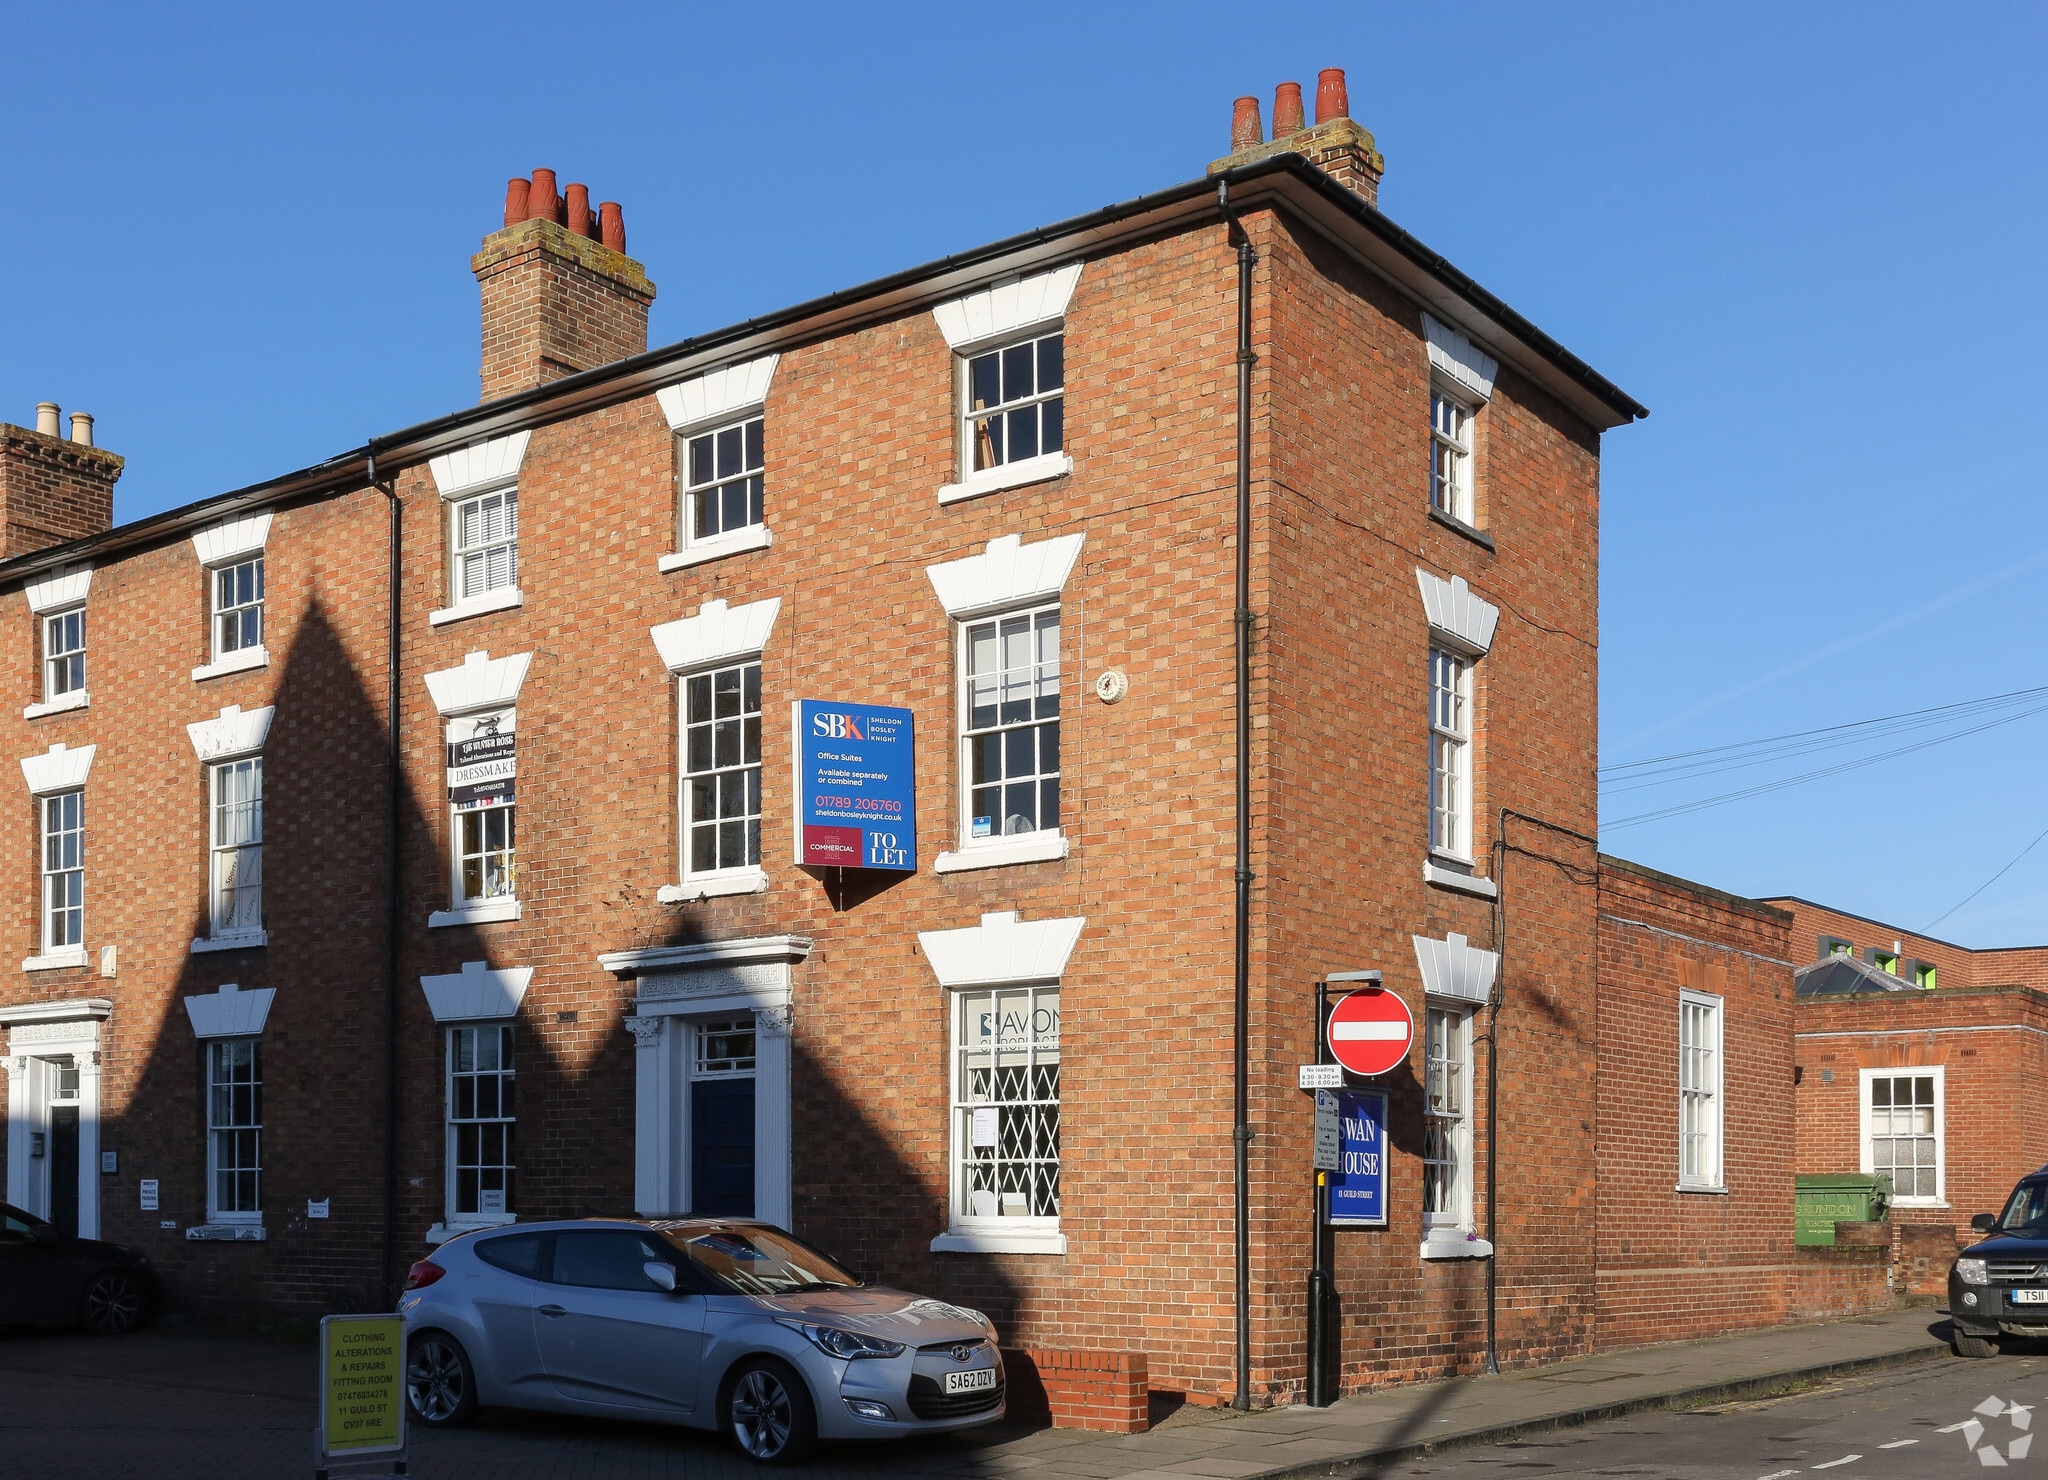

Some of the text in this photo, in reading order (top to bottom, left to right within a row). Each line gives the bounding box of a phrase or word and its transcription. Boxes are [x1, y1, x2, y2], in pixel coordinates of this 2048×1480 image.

[813, 712, 864, 740] SBK
[871, 717, 902, 725] SHELDON
[871, 726, 896, 734] BOSLEY
[817, 752, 863, 762] Office Suites
[818, 768, 888, 781] Available separately
[827, 777, 863, 786] combined
[815, 795, 902, 812] 01789 206760
[815, 809, 902, 821] sheldonbosleyknight.co.uk
[870, 831, 897, 849] TO
[810, 843, 854, 853] COMMERCIAL
[871, 847, 908, 865] LET
[1319, 1091, 1324, 1105] P
[1339, 1117, 1375, 1141] SWAN
[342, 1333, 386, 1343] CLOTHING
[335, 1347, 393, 1358] ALTERATIONS
[342, 1361, 386, 1372] & REPAIRS
[333, 1375, 393, 1387] FITTING ROOM
[950, 1373, 976, 1389] SA62
[337, 1389, 388, 1401] 07476034278
[339, 1404, 388, 1415] 11 GUILD ST
[343, 1418, 382, 1429] CV37 6RE
